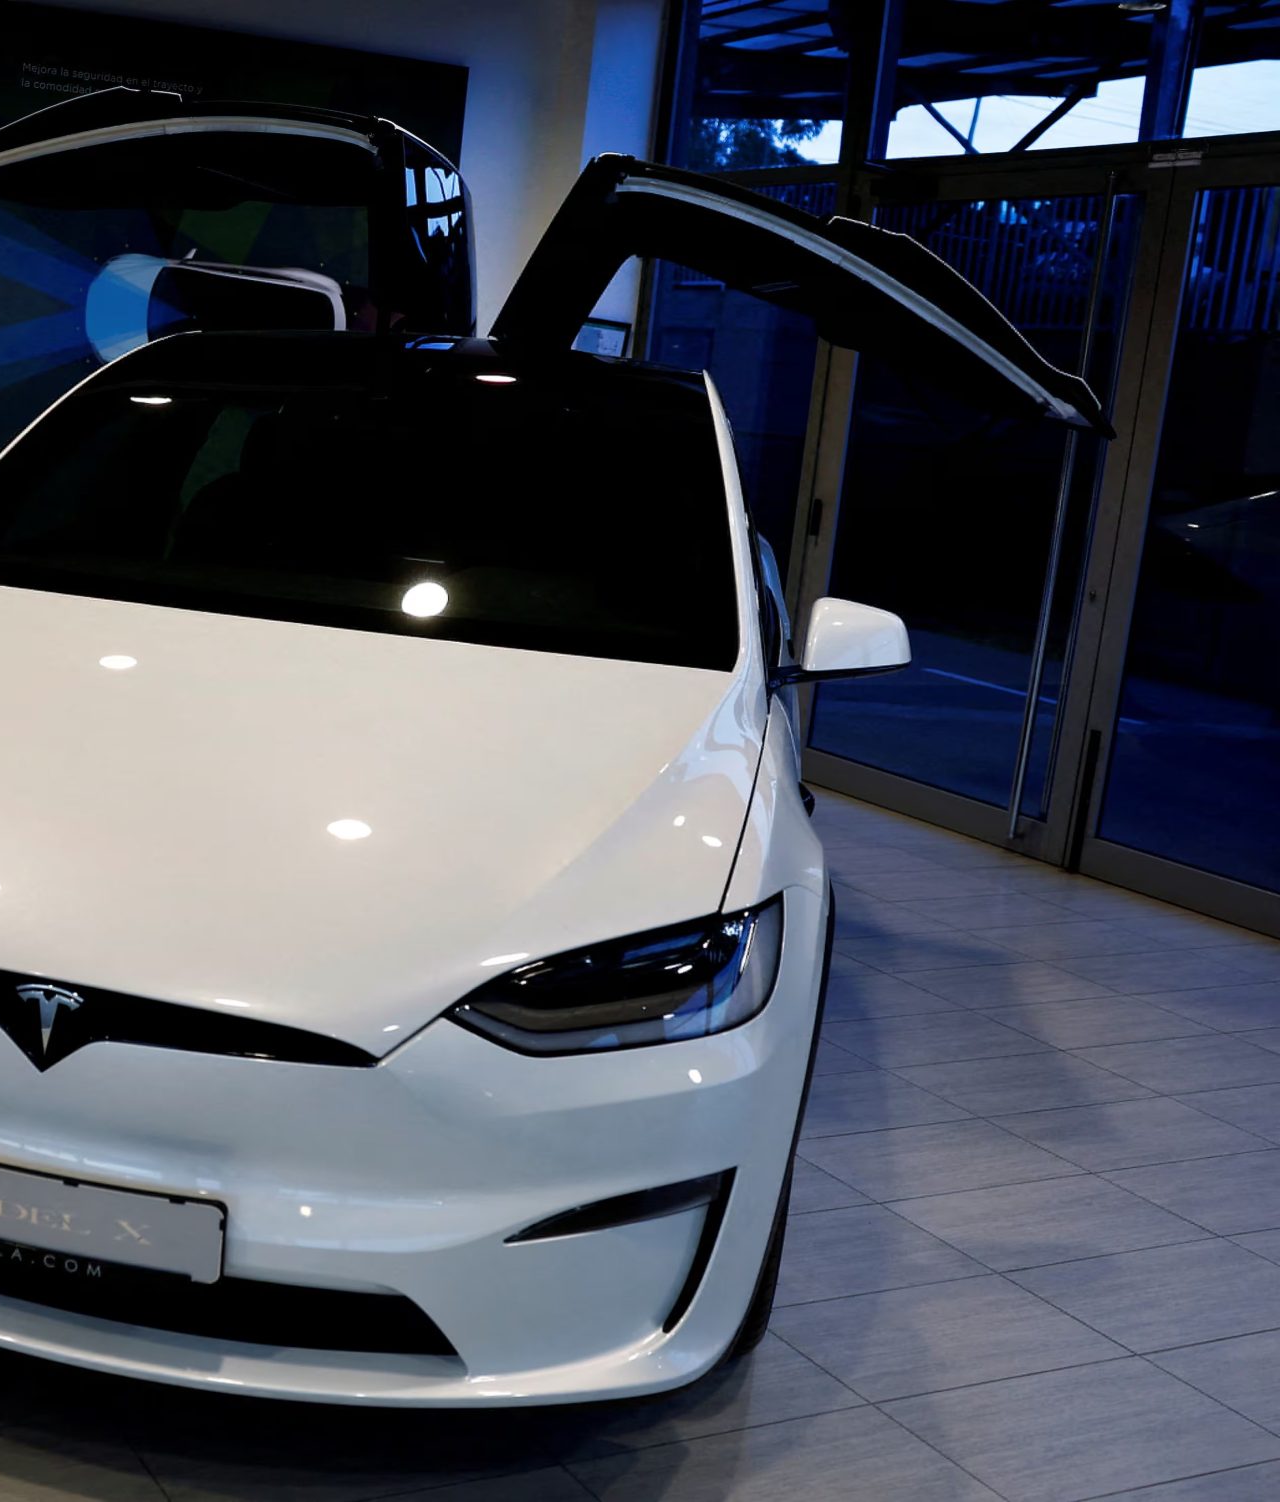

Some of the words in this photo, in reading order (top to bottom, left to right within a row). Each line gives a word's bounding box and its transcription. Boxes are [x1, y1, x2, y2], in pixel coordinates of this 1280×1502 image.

[21, 77, 30, 88] la
[34, 80, 92, 94] comodidad
[23, 62, 58, 76] Mejora
[61, 67, 69, 76] la
[73, 69, 123, 83] seguridad
[127, 77, 138, 85] en
[153, 80, 195, 93] trayecto
[114, 1218, 152, 1246] X
